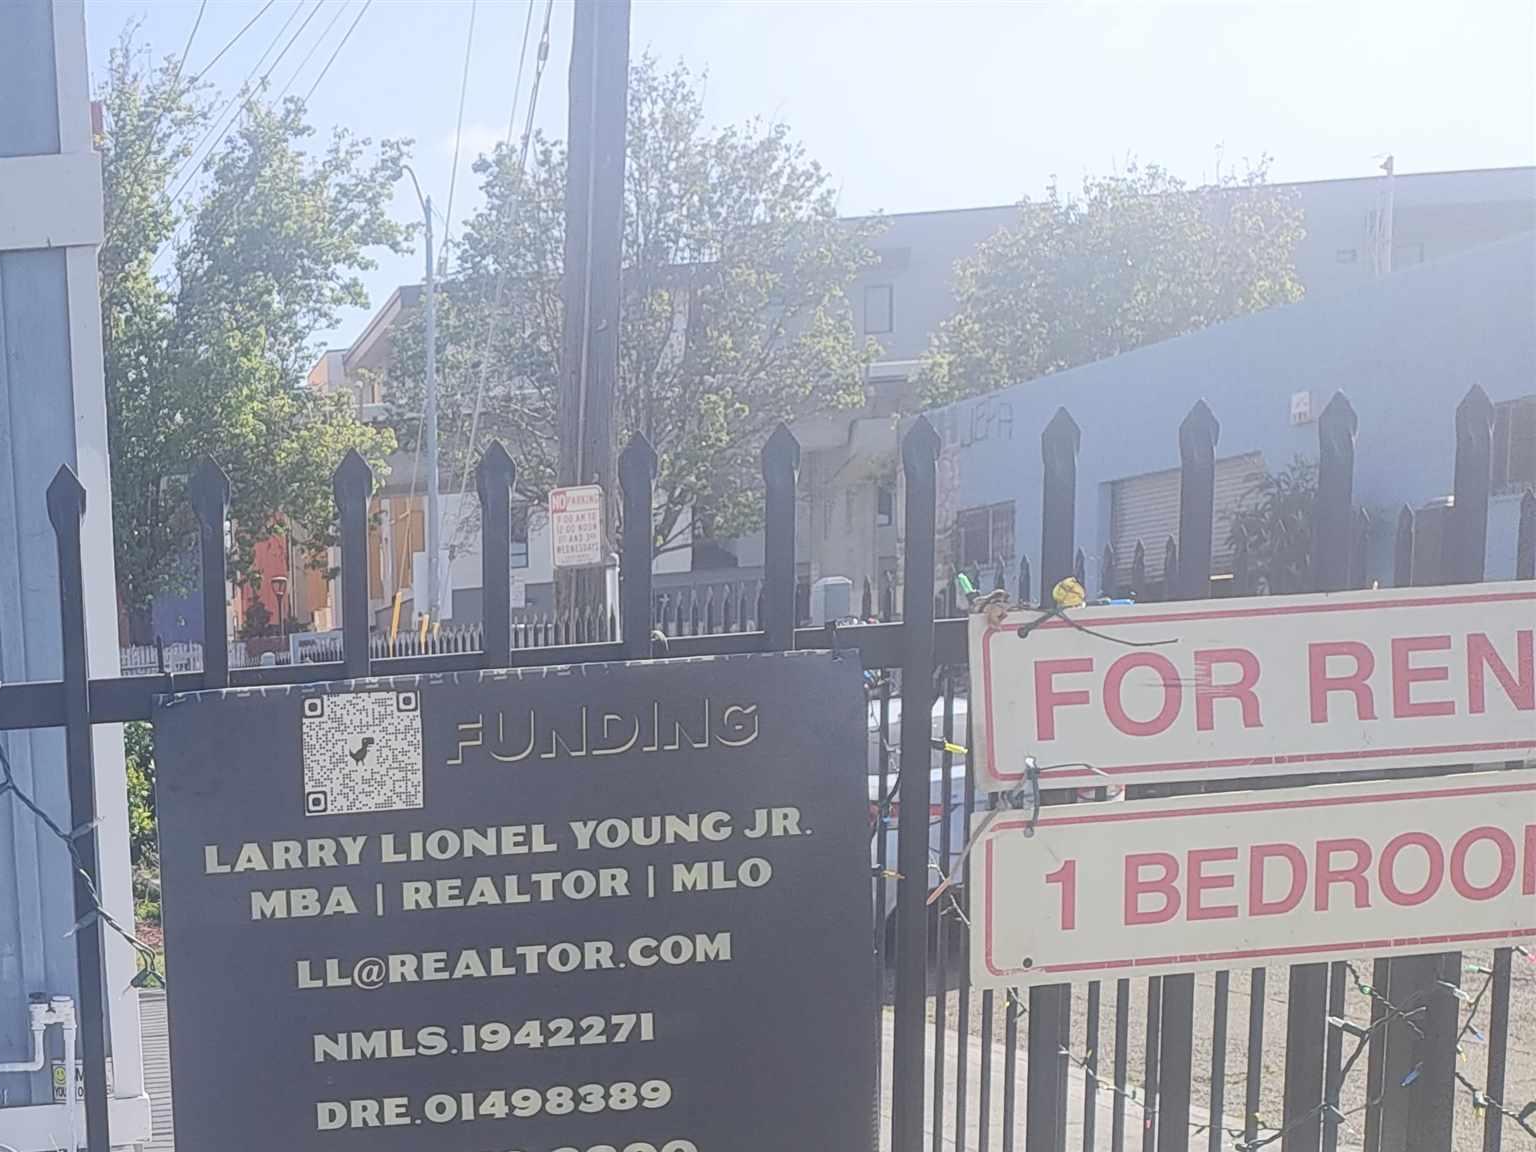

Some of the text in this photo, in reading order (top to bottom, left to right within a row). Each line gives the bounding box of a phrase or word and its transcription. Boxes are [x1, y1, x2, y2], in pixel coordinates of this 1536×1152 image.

[1034, 647, 1265, 742] FOR
[447, 698, 758, 765] FUNDING
[205, 807, 813, 874] LARRY LIONEL YOUNG JR.
[250, 887, 359, 919] MBA
[402, 868, 630, 911] REALTOR
[672, 857, 772, 893] MLO
[1045, 824, 1536, 931] 1 BEDROO
[297, 932, 732, 990] LL@REALTOR.COM
[313, 1012, 654, 1063] NMLS.1942271
[316, 1079, 672, 1130] DRE.01498389
